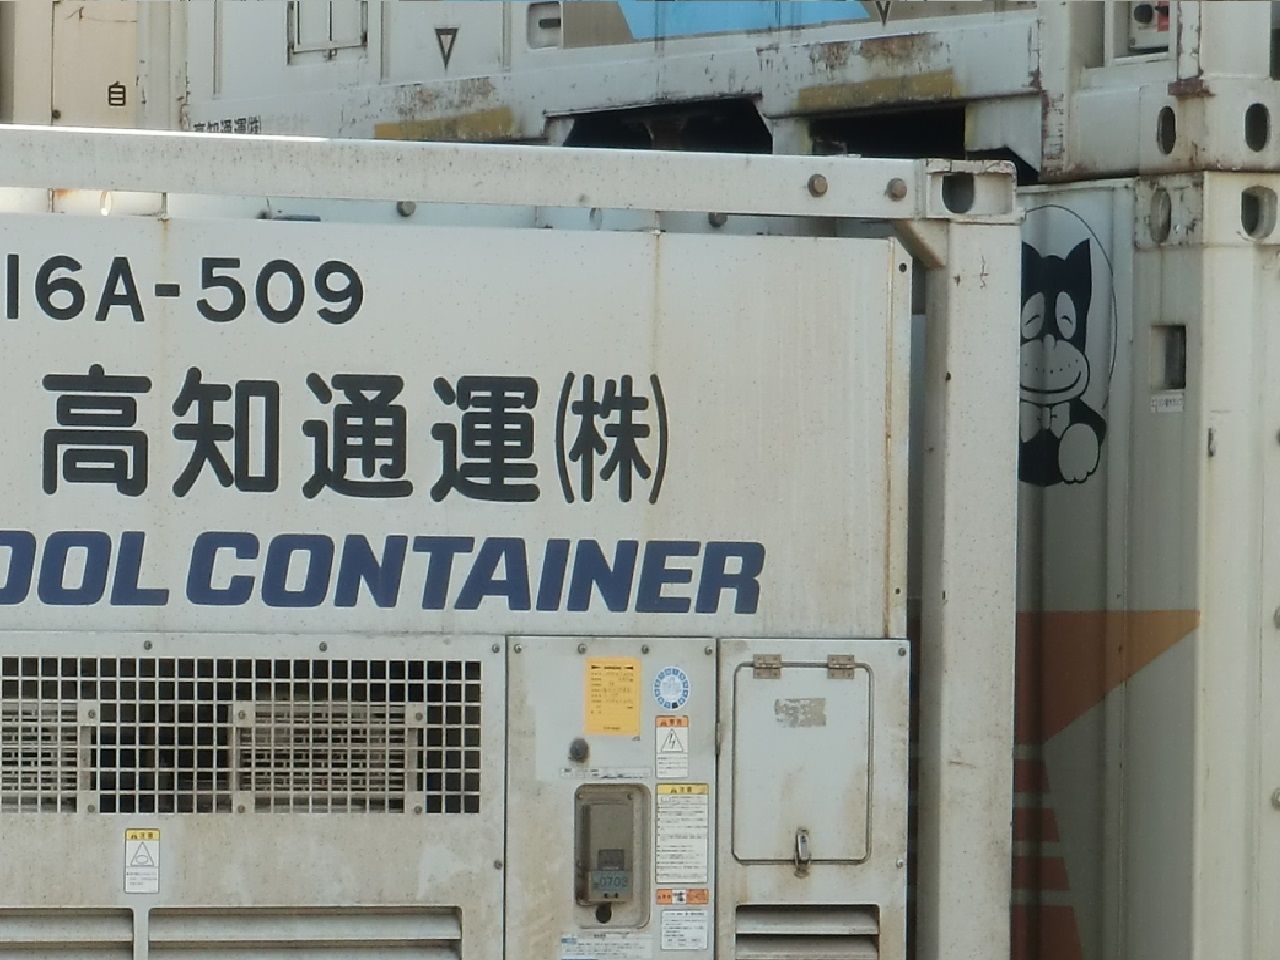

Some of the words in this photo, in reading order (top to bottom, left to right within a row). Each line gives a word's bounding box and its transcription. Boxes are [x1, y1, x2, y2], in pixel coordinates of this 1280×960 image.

[108, 81, 126, 107] 自
[41, 364, 670, 504] 高知通運(株)
[184, 530, 767, 615] CONTAINER
